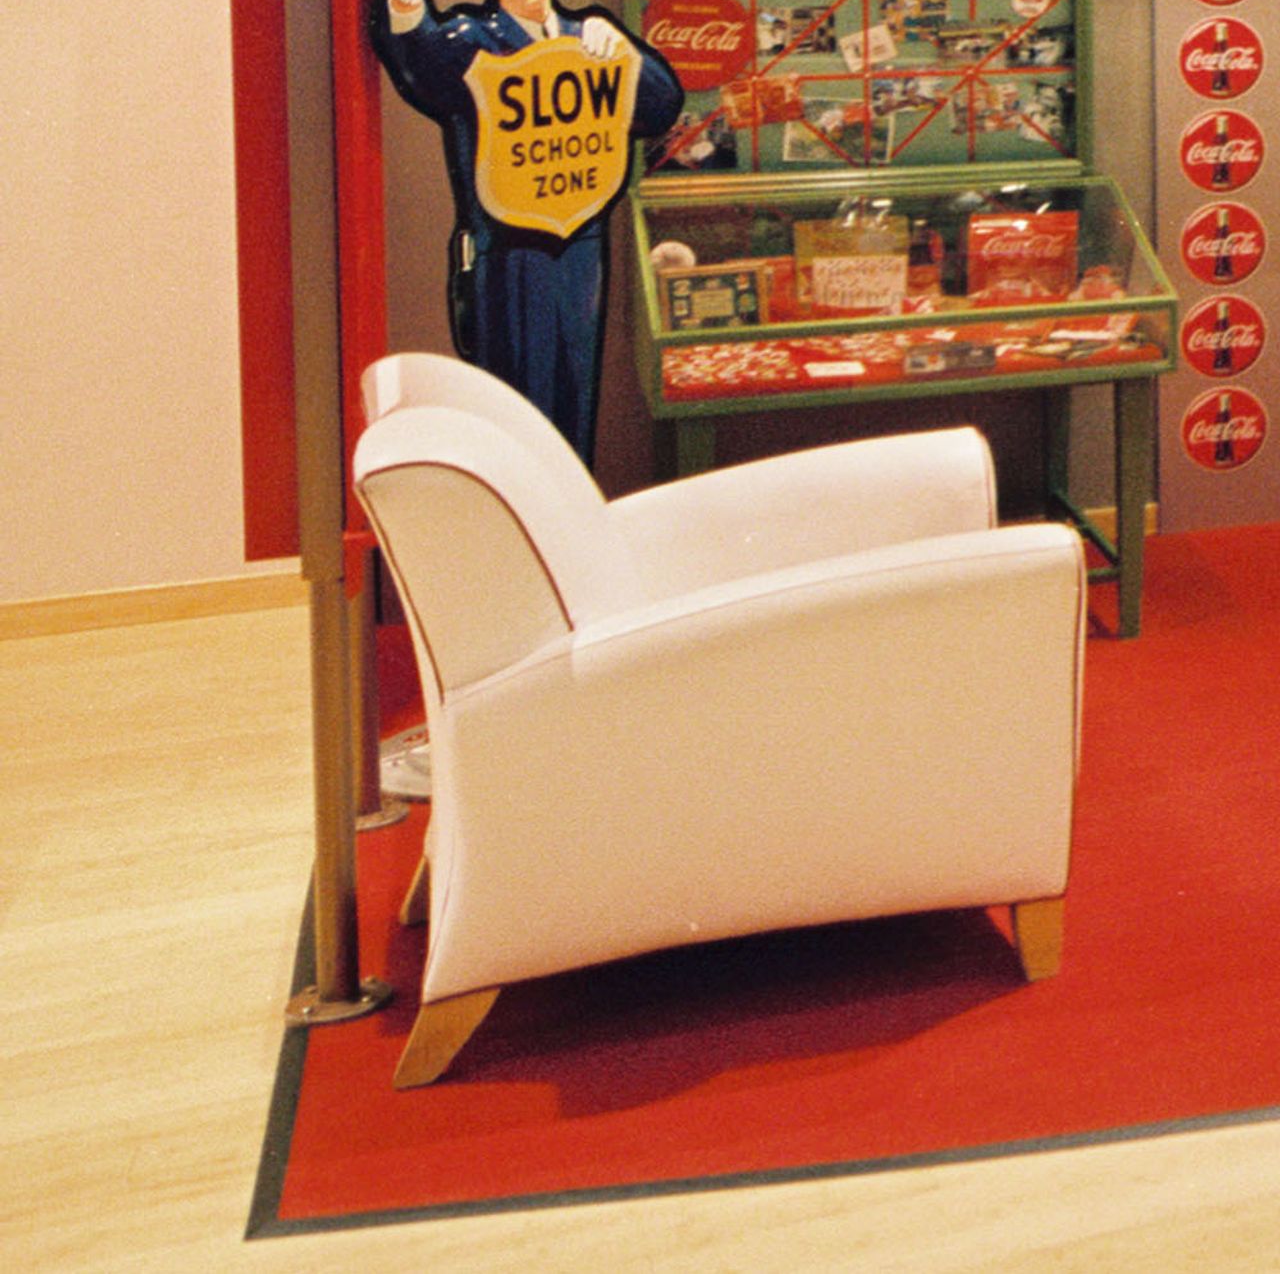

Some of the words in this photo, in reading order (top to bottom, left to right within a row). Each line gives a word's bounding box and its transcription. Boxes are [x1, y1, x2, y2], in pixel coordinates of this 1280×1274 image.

[646, 18, 745, 51] Coca-Cola
[1186, 47, 1258, 71] Coca-Cola
[499, 66, 621, 132] SLOW
[511, 131, 614, 168] SCHOOL
[1186, 140, 1259, 165] Coca-Cola
[533, 167, 597, 199] ZONE
[1188, 232, 1260, 259] Coca-Cola
[1188, 325, 1260, 350] Coca-Cola
[1188, 417, 1261, 443] Coca-Cola
